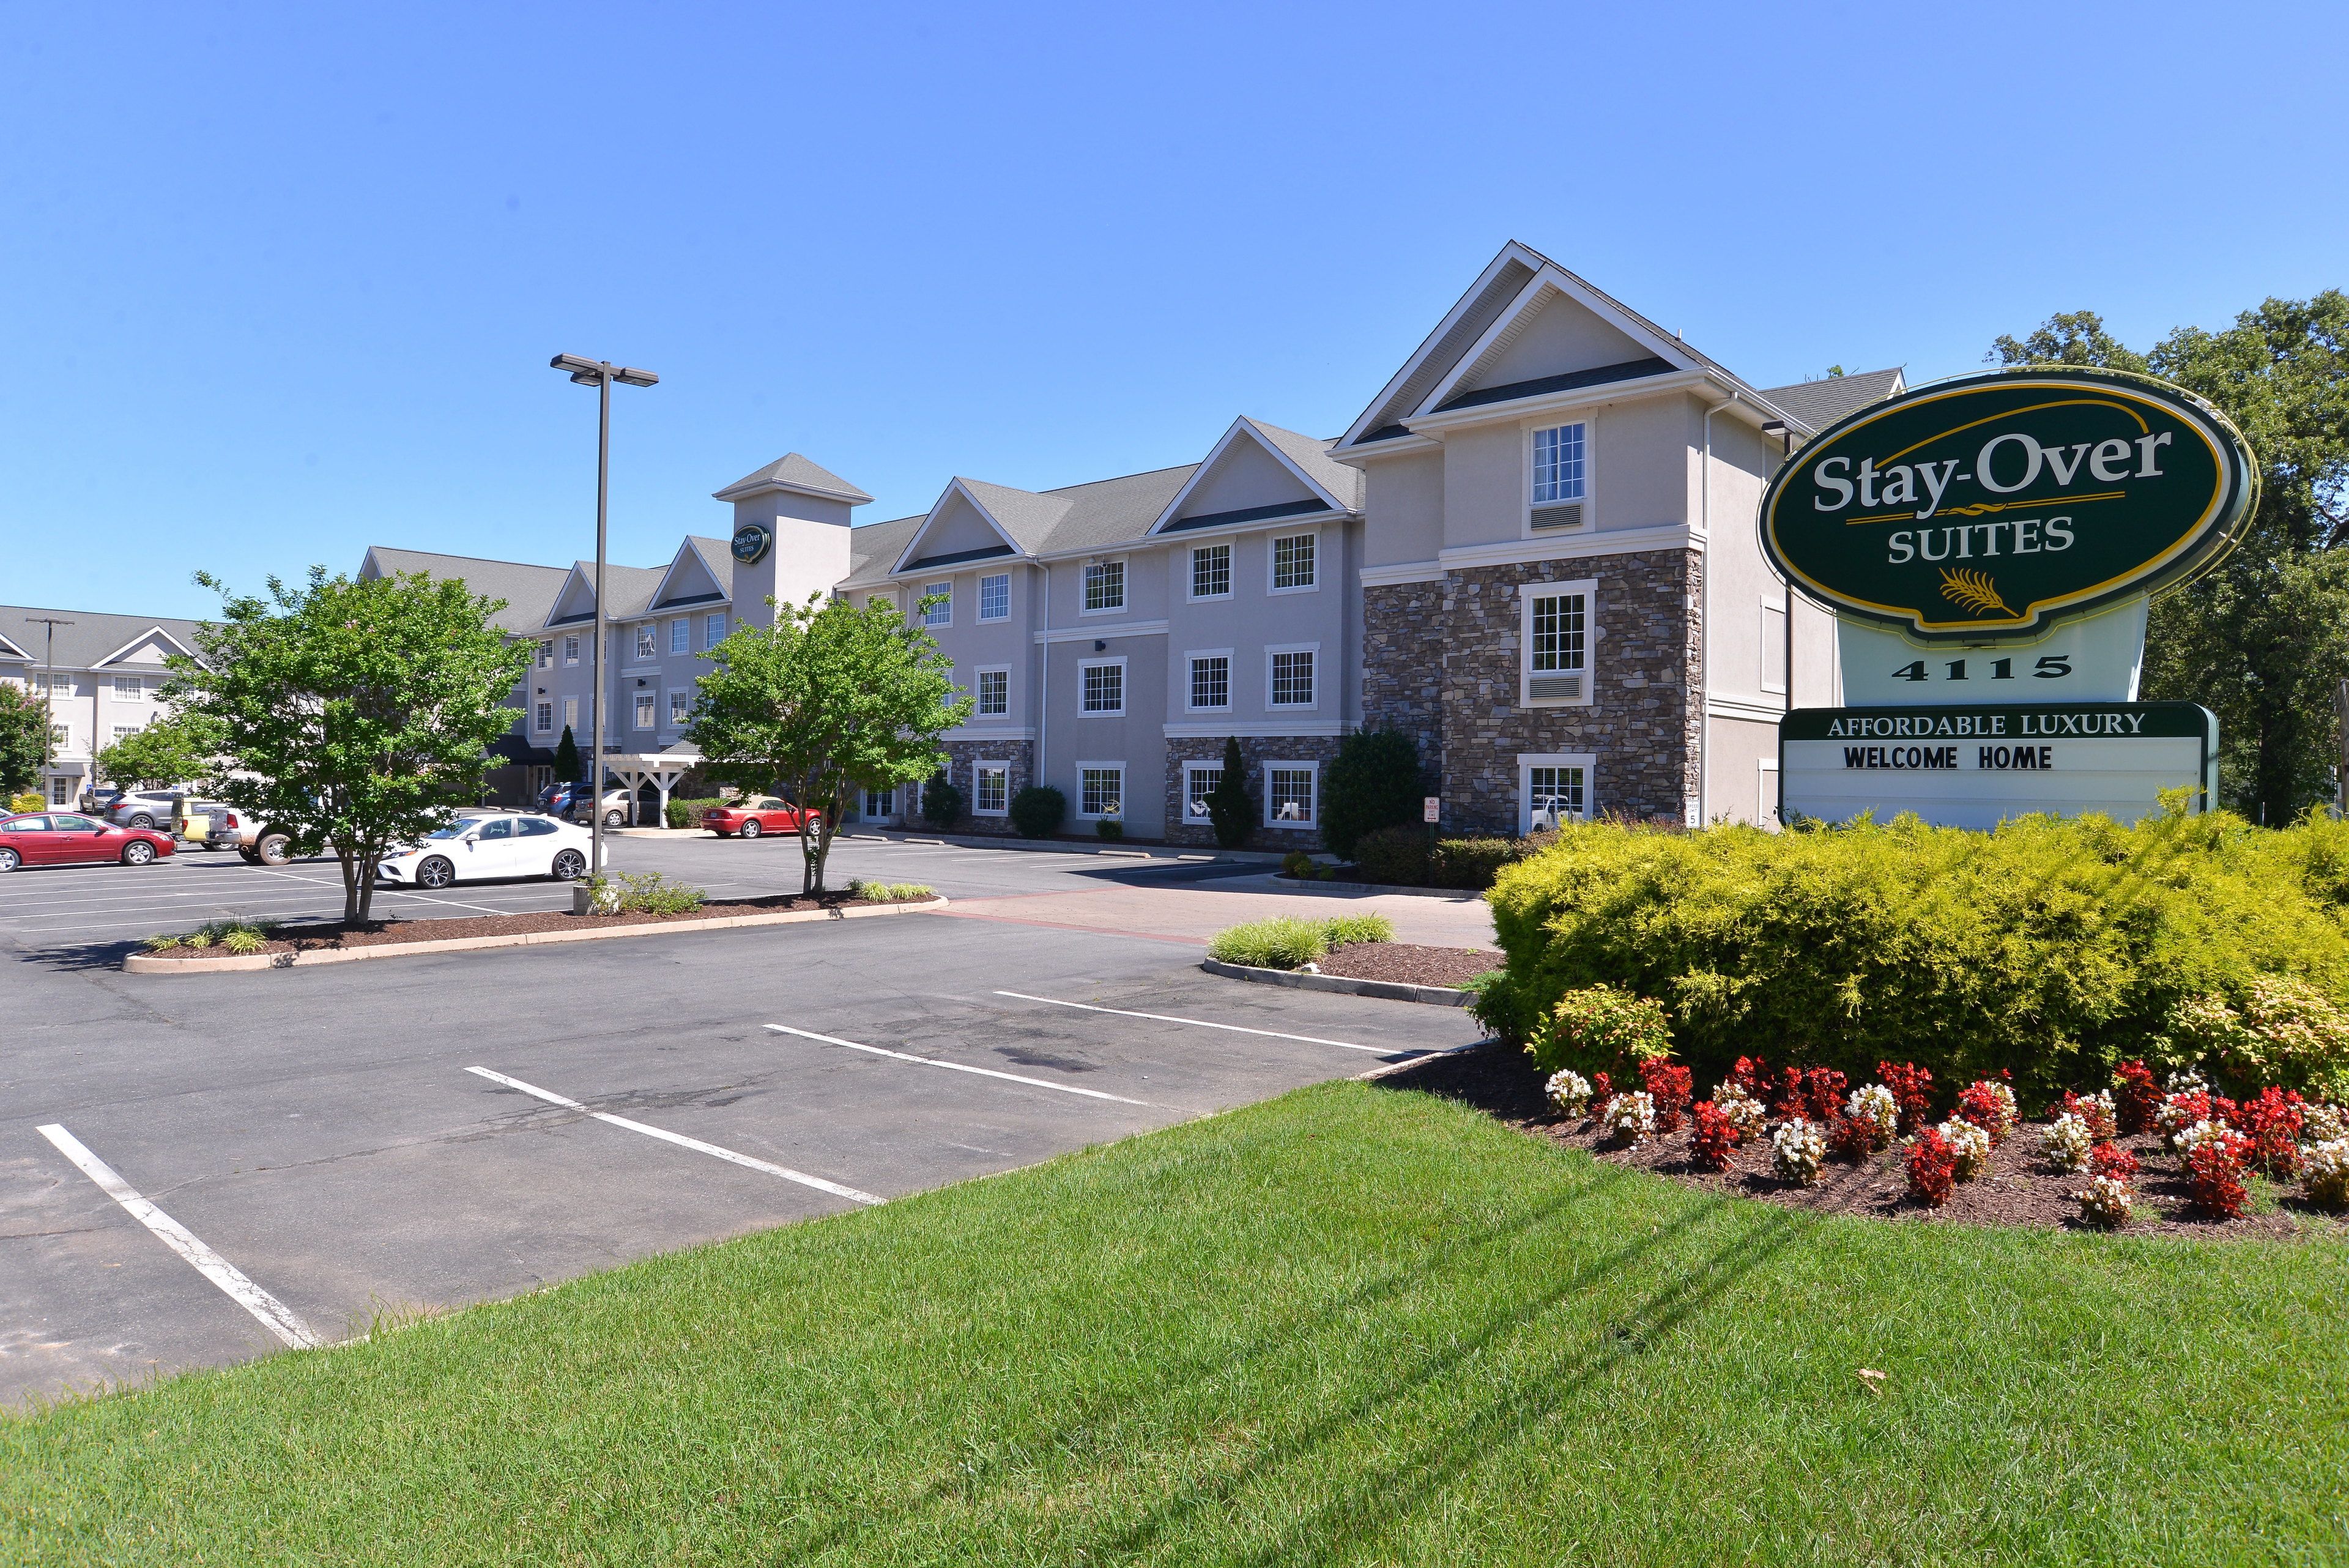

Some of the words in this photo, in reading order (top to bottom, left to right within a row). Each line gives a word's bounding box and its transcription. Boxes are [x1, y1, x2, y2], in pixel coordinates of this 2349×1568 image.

[1814, 432, 2172, 519] Stay-Over
[1888, 516, 2074, 564] SUITES
[1891, 655, 2073, 682] 4115
[1827, 715, 2006, 737] AFFORDABLE
[2021, 713, 2146, 734] LUXURY
[1843, 746, 1958, 768] WELCOME
[1978, 746, 2052, 768] HOME
